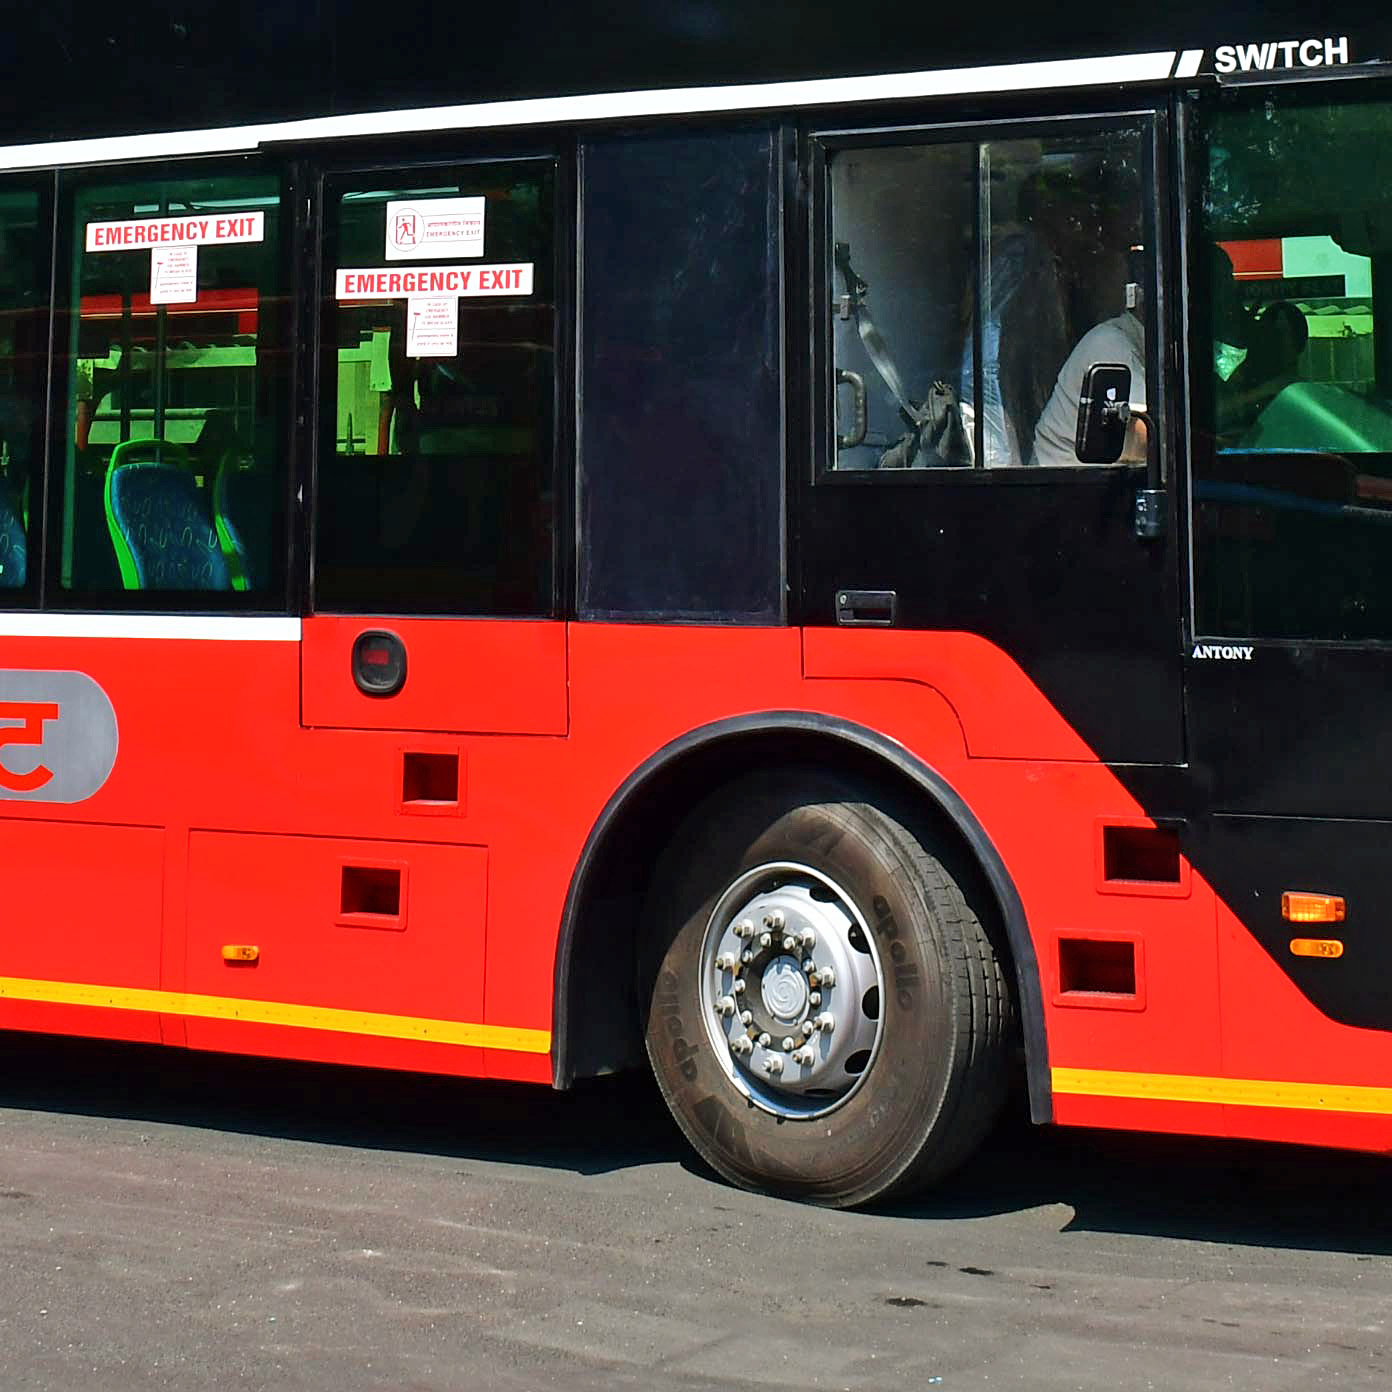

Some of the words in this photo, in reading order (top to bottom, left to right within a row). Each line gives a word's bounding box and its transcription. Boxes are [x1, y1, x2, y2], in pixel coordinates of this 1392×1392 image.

[1214, 37, 1348, 73] SWITCH
[94, 221, 209, 246] EMERGENCY
[215, 217, 256, 238] EXIT
[344, 271, 472, 293] EMERGENCY
[479, 269, 523, 290] EXIT
[1191, 645, 1255, 660] ANTONY
[872, 895, 920, 1011] apollo
